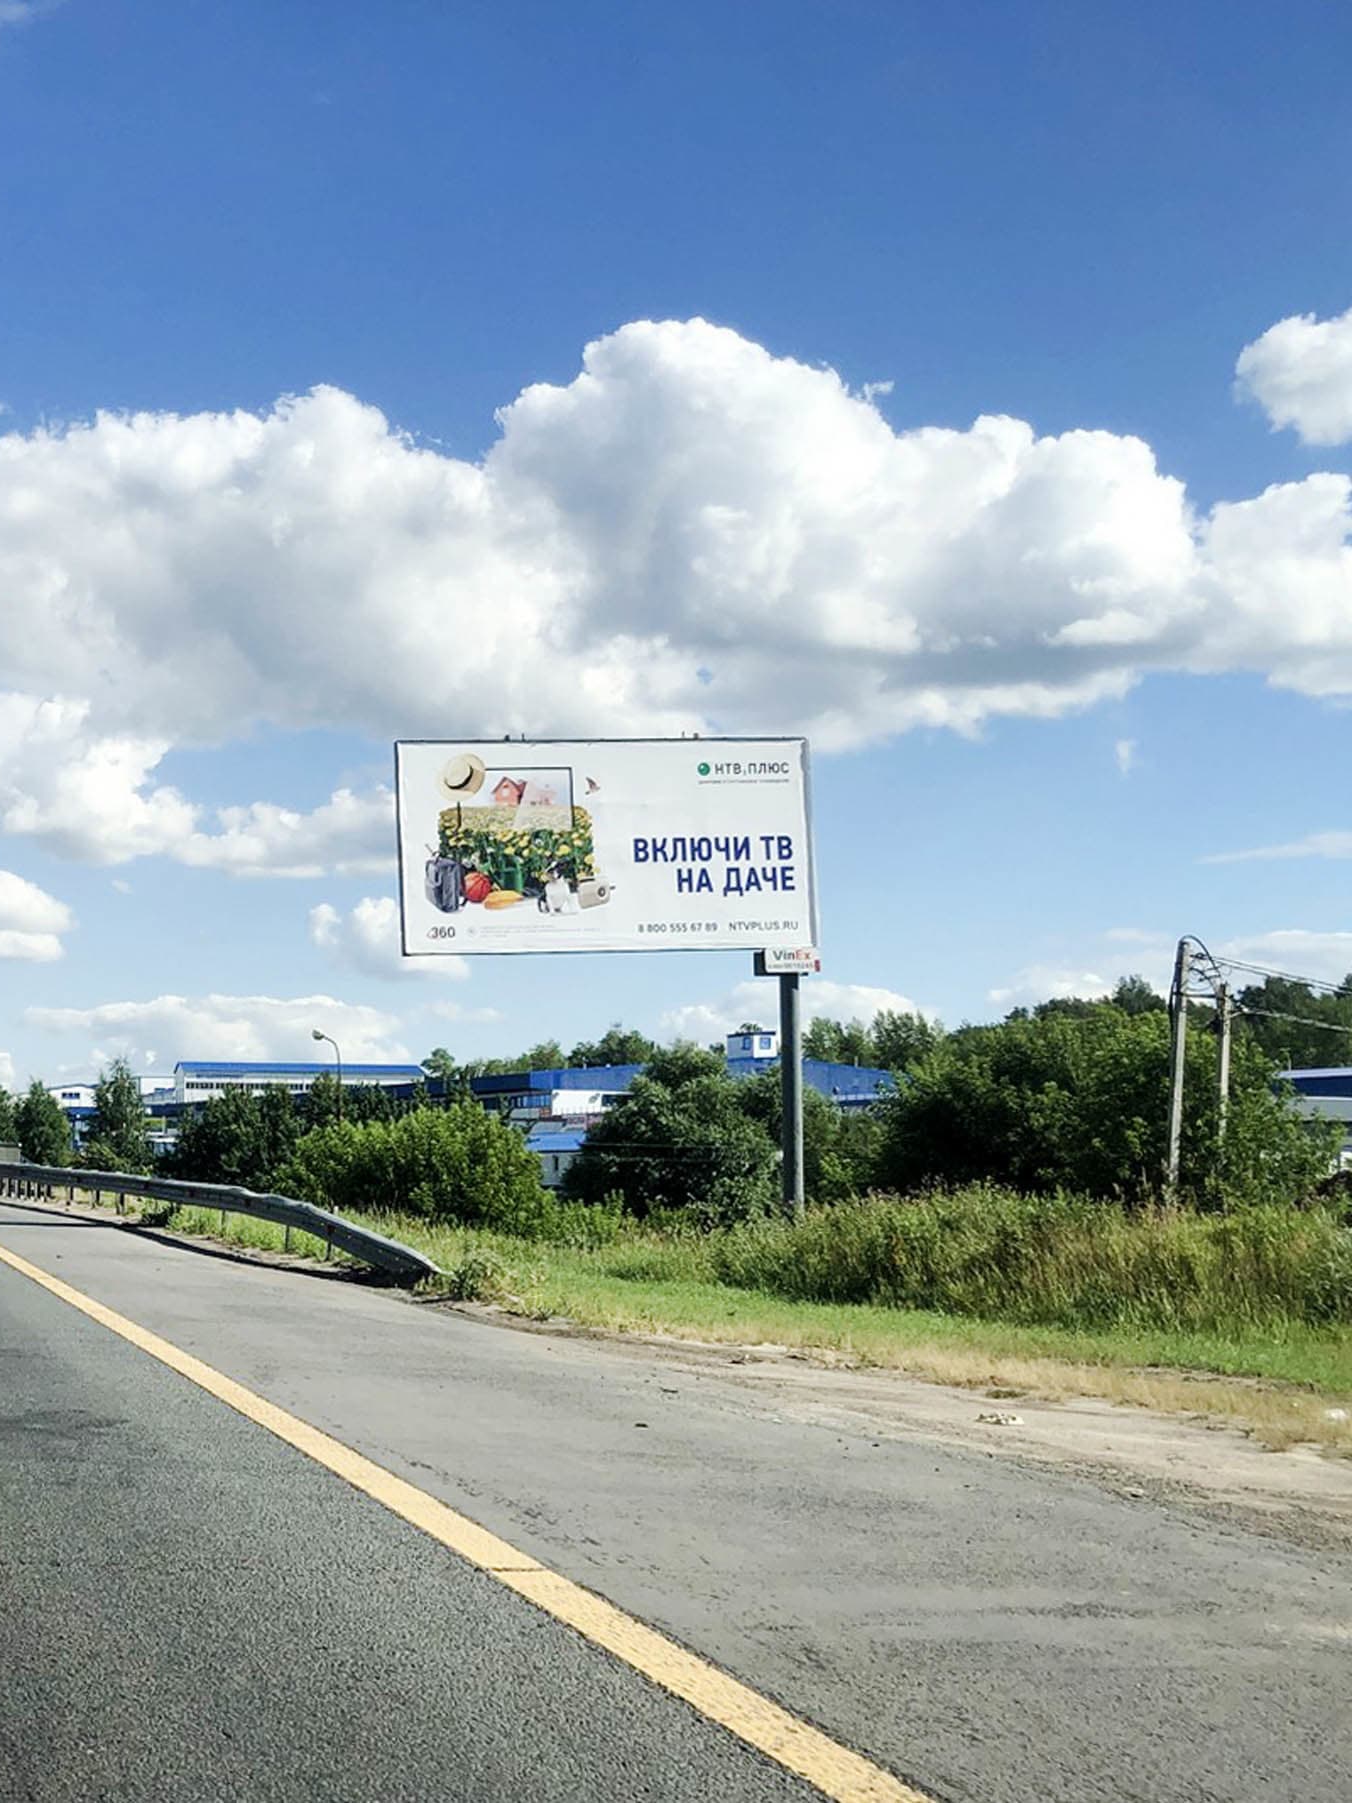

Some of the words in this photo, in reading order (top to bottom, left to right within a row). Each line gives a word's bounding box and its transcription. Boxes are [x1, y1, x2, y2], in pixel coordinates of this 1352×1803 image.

[633, 836, 750, 863] ВКЛЮЧИ
[759, 835, 793, 861] ТВ
[677, 868, 713, 893] НА
[723, 866, 796, 897] ДАЧЕ
[430, 926, 456, 938] 360
[647, 923, 667, 933] 800
[669, 923, 688, 932] 555
[691, 922, 702, 932] 67
[704, 921, 718, 932] 89
[728, 920, 798, 931] NTVPLUS.RU
